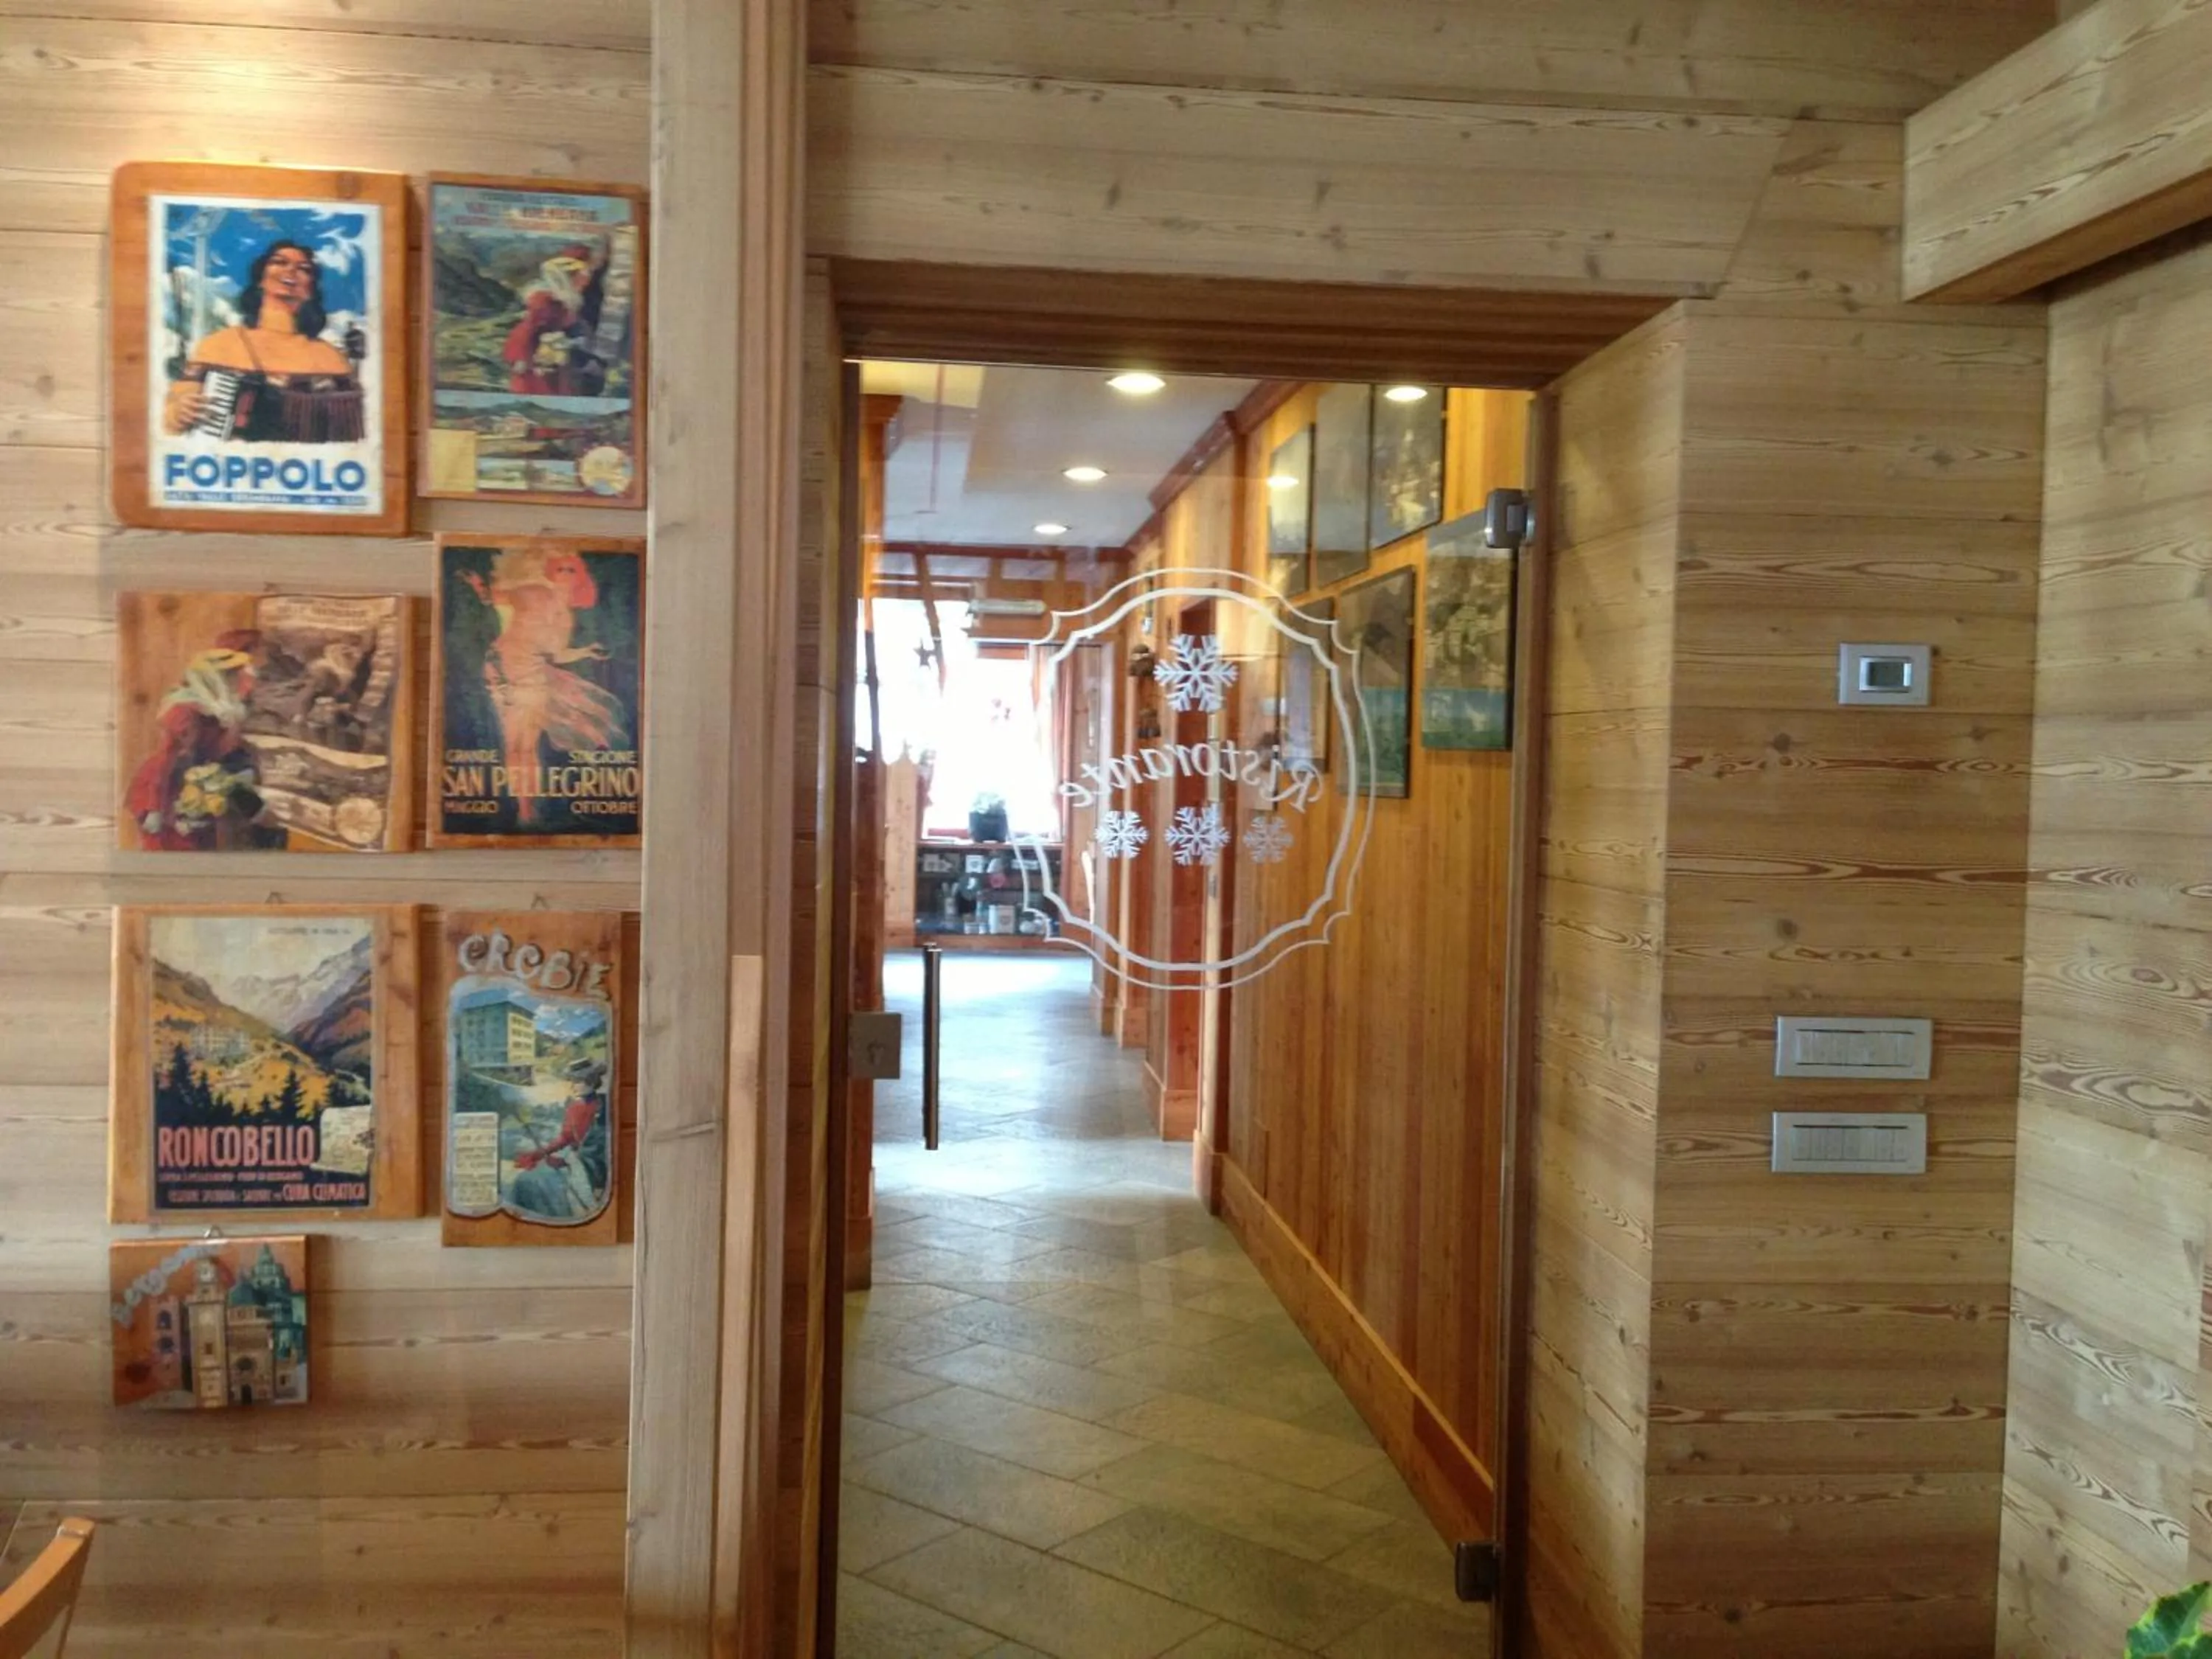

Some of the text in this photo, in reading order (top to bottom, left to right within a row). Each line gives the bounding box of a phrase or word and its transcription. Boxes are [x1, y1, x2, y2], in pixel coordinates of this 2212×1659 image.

[164, 453, 367, 493] FOPPOLO
[445, 748, 638, 764] GRANDE STAGIONE
[441, 766, 639, 798] SAN PELLEGRINO
[444, 801, 638, 815] MAGGIO OTTOBRE
[157, 1125, 316, 1167] RONCOBELLO
